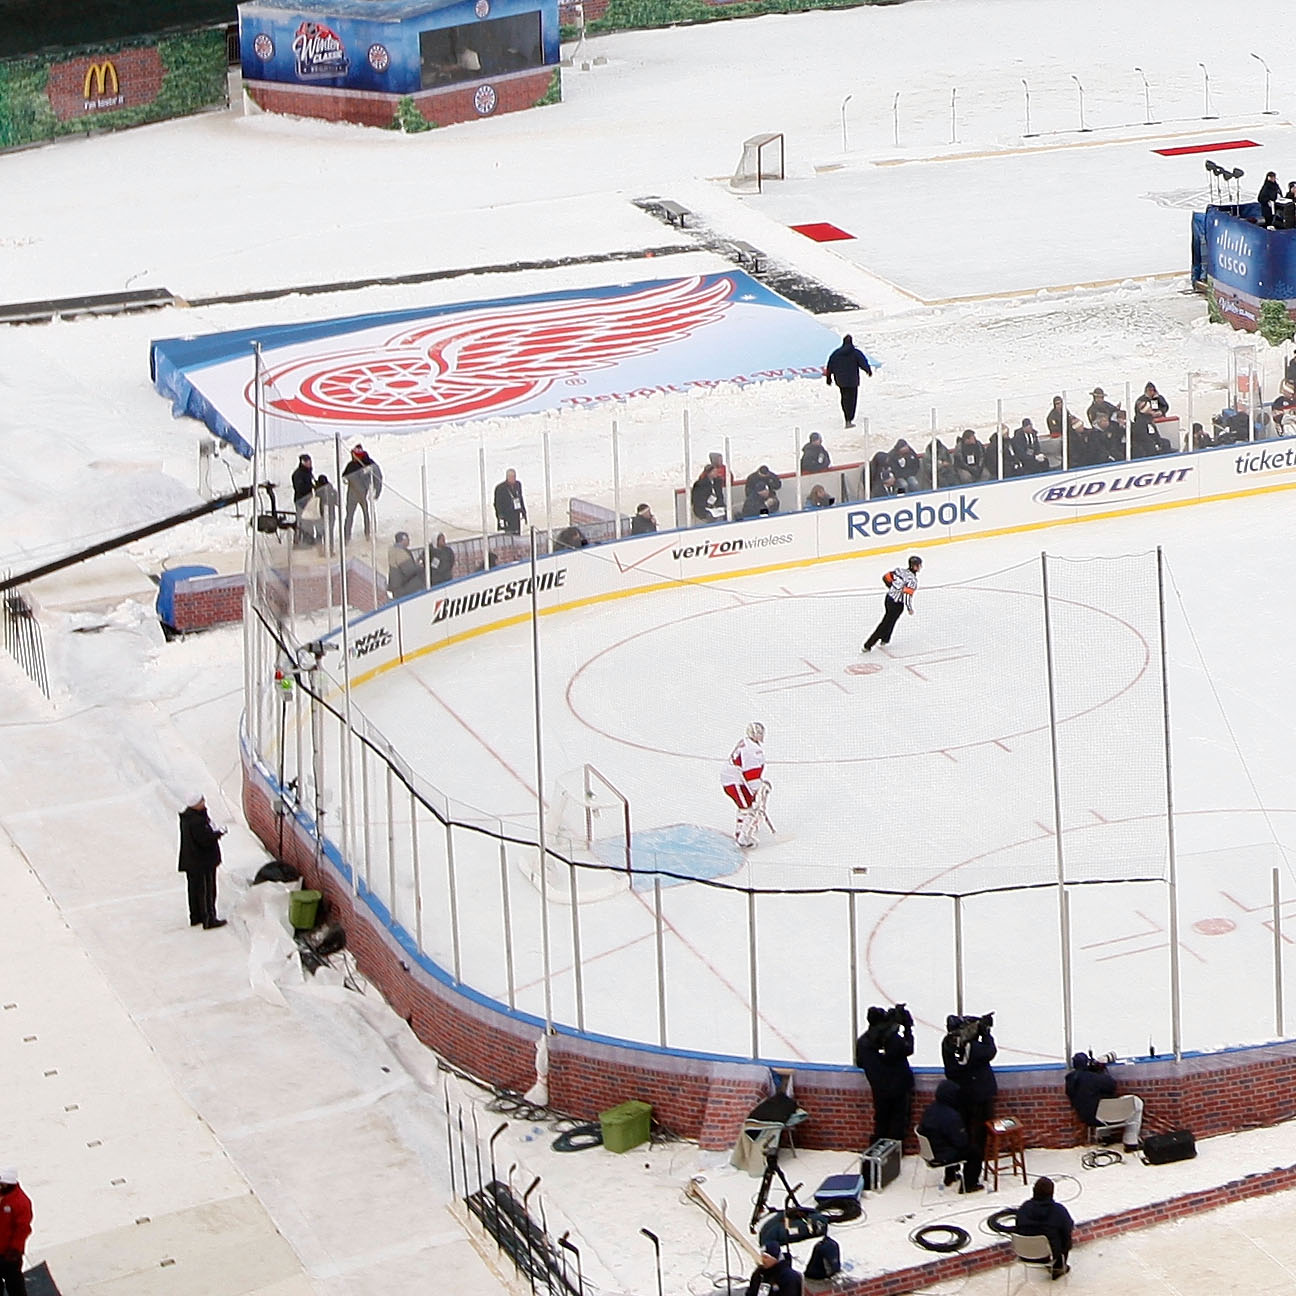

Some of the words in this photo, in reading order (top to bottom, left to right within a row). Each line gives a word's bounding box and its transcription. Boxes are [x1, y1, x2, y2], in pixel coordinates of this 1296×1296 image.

[292, 32, 340, 66] Winter
[1218, 254, 1247, 276] CISCO
[1044, 480, 1106, 503] BUD
[1111, 467, 1194, 492] LIGHT
[847, 494, 980, 540] Reebok
[672, 538, 745, 561] verizon
[744, 530, 795, 552] wireless
[431, 568, 567, 625] BRIDGESTONE
[354, 626, 388, 648] NHL
